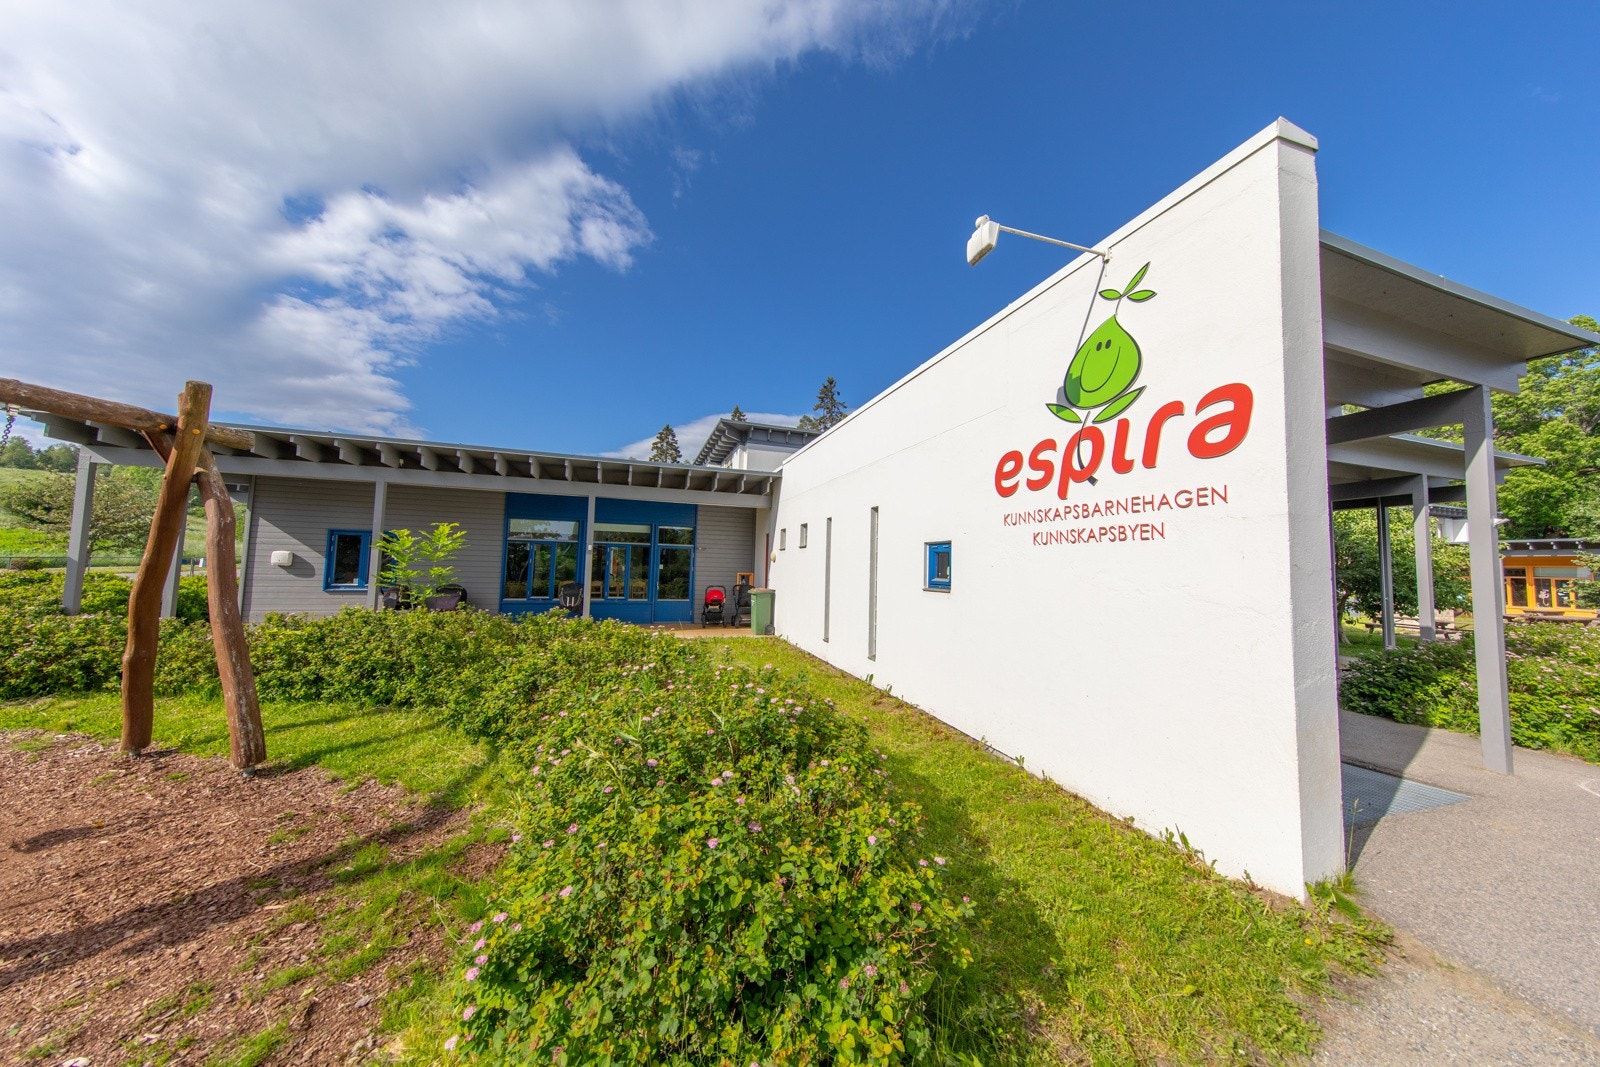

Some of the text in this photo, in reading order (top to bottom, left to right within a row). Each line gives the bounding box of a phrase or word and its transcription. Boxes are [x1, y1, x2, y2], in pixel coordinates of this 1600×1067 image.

[995, 383, 1253, 500] espira
[1003, 485, 1229, 527] KUNNSKAPSBARNEHAGEN
[1033, 522, 1166, 546] KUNNSKAPSBYEN
